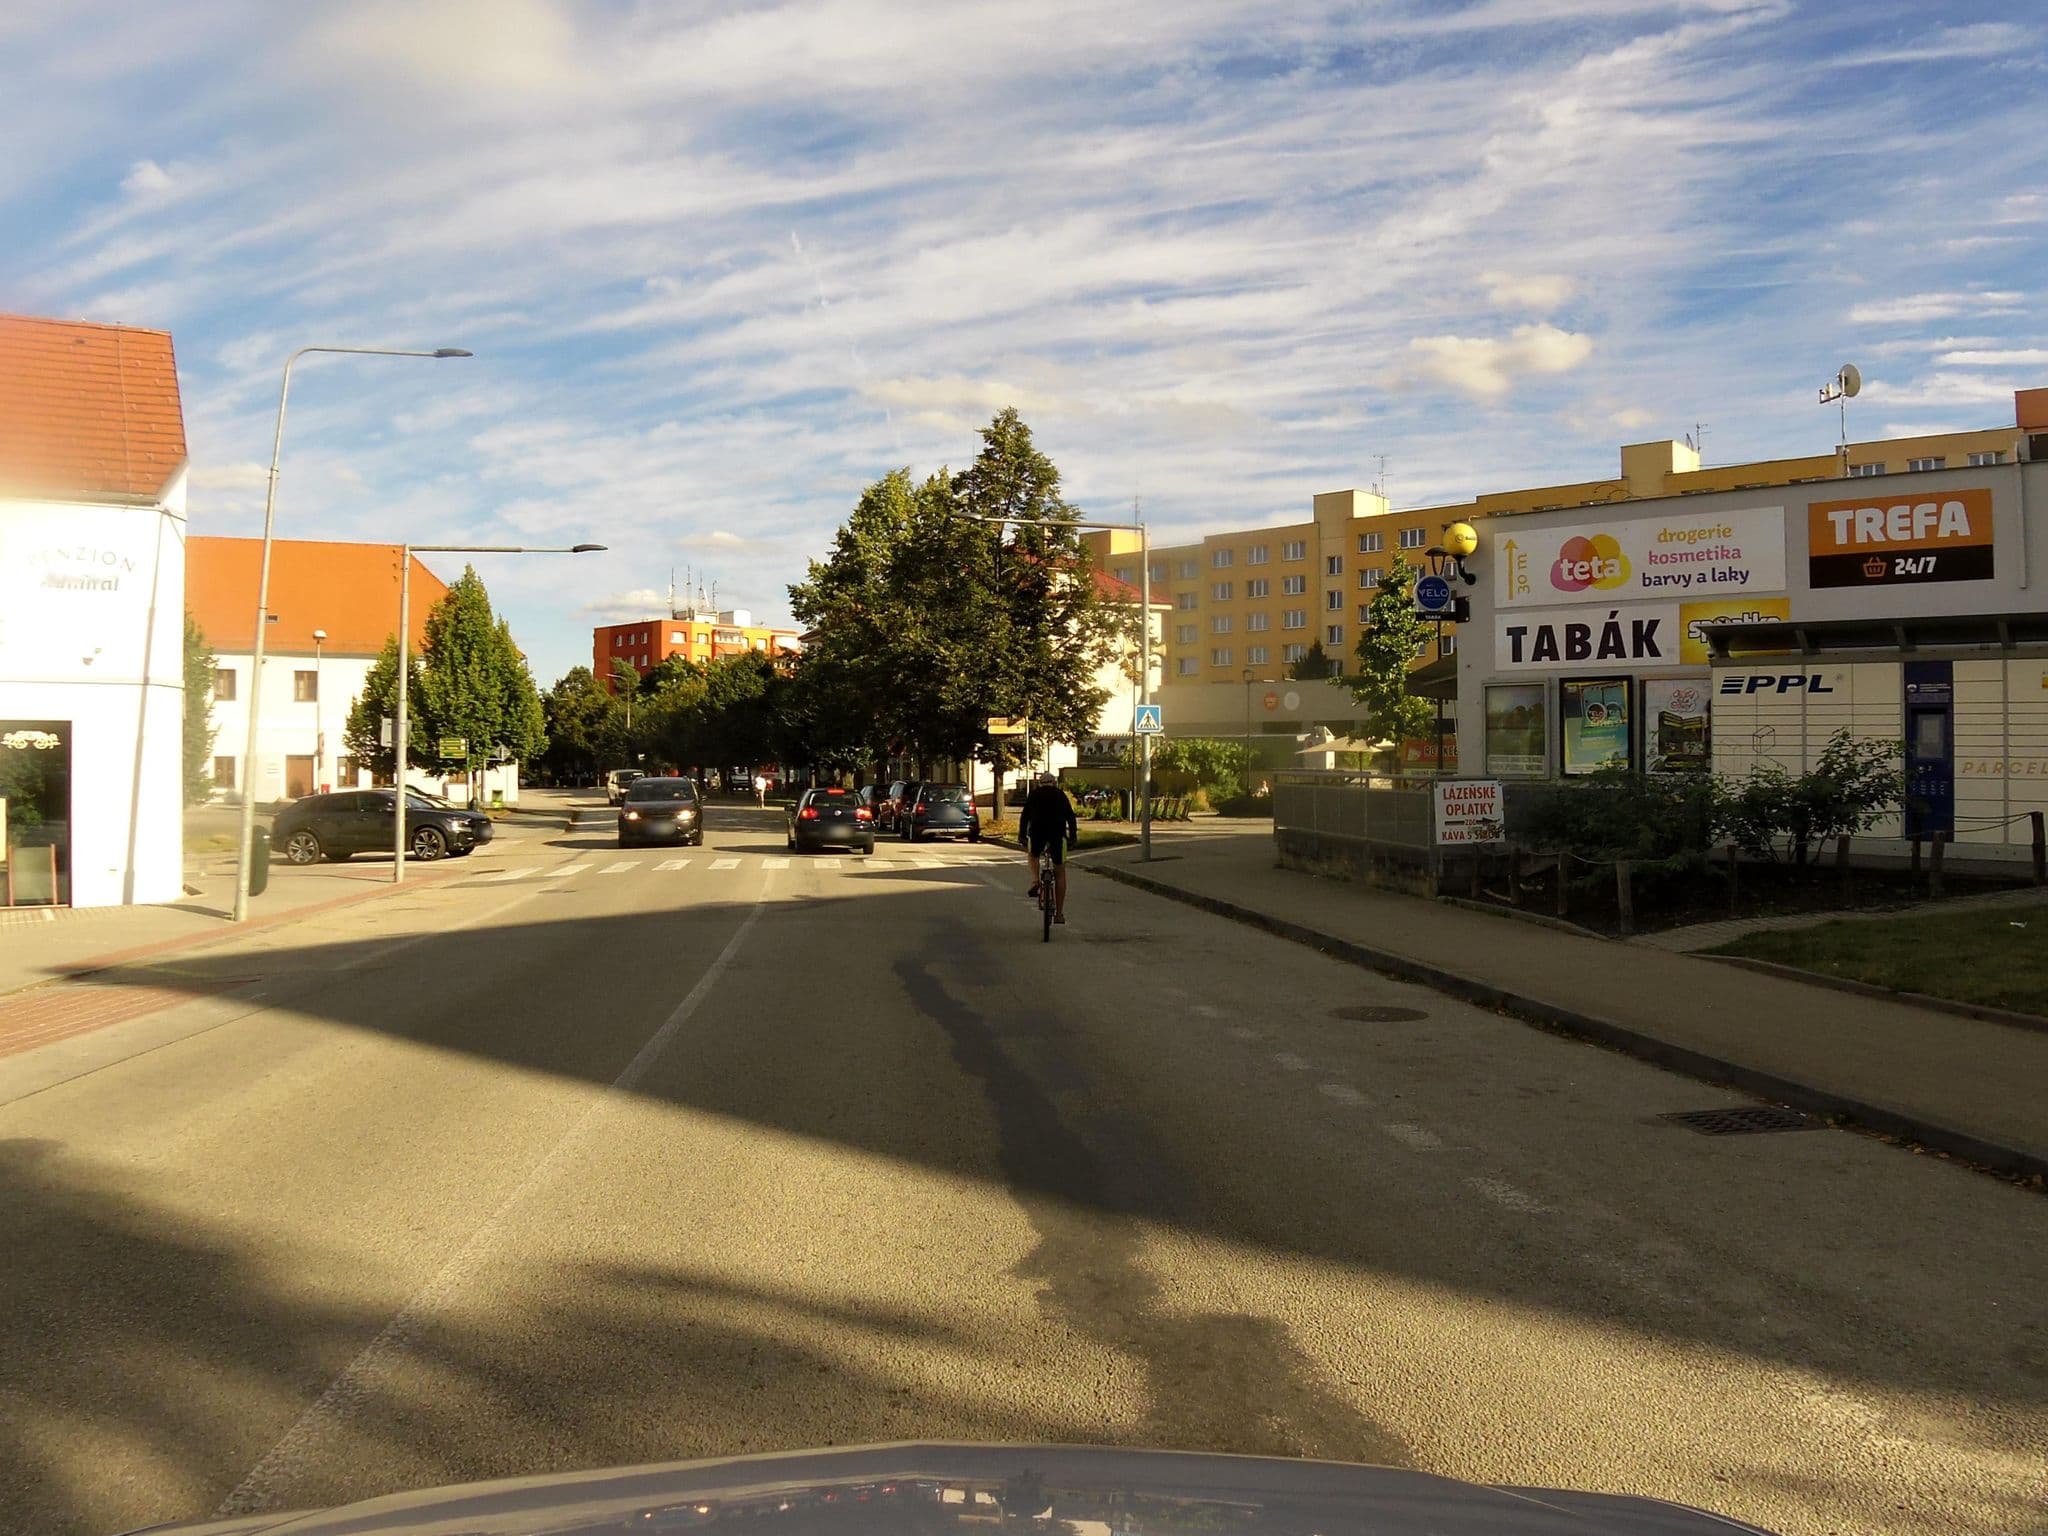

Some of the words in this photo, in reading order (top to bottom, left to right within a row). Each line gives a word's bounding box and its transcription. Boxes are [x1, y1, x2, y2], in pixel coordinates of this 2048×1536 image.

[1827, 501, 1971, 545] TREFA
[1657, 524, 1732, 544] drogerie
[1517, 554, 1527, 569] m
[1648, 545, 1742, 566] kosmetika
[1894, 556, 1937, 575] 24/7
[1560, 555, 1621, 581] teta
[1642, 572, 1692, 589] barvy
[1697, 573, 1706, 583] a
[1711, 567, 1750, 585] laky
[1418, 588, 1449, 597] VELO
[1517, 575, 1530, 593] 30
[1506, 610, 1662, 663] TABÁK
[1745, 674, 1834, 694] PPL
[1443, 784, 1496, 801] LÁZEŇSKÉ
[1446, 803, 1495, 816] OPLATKY
